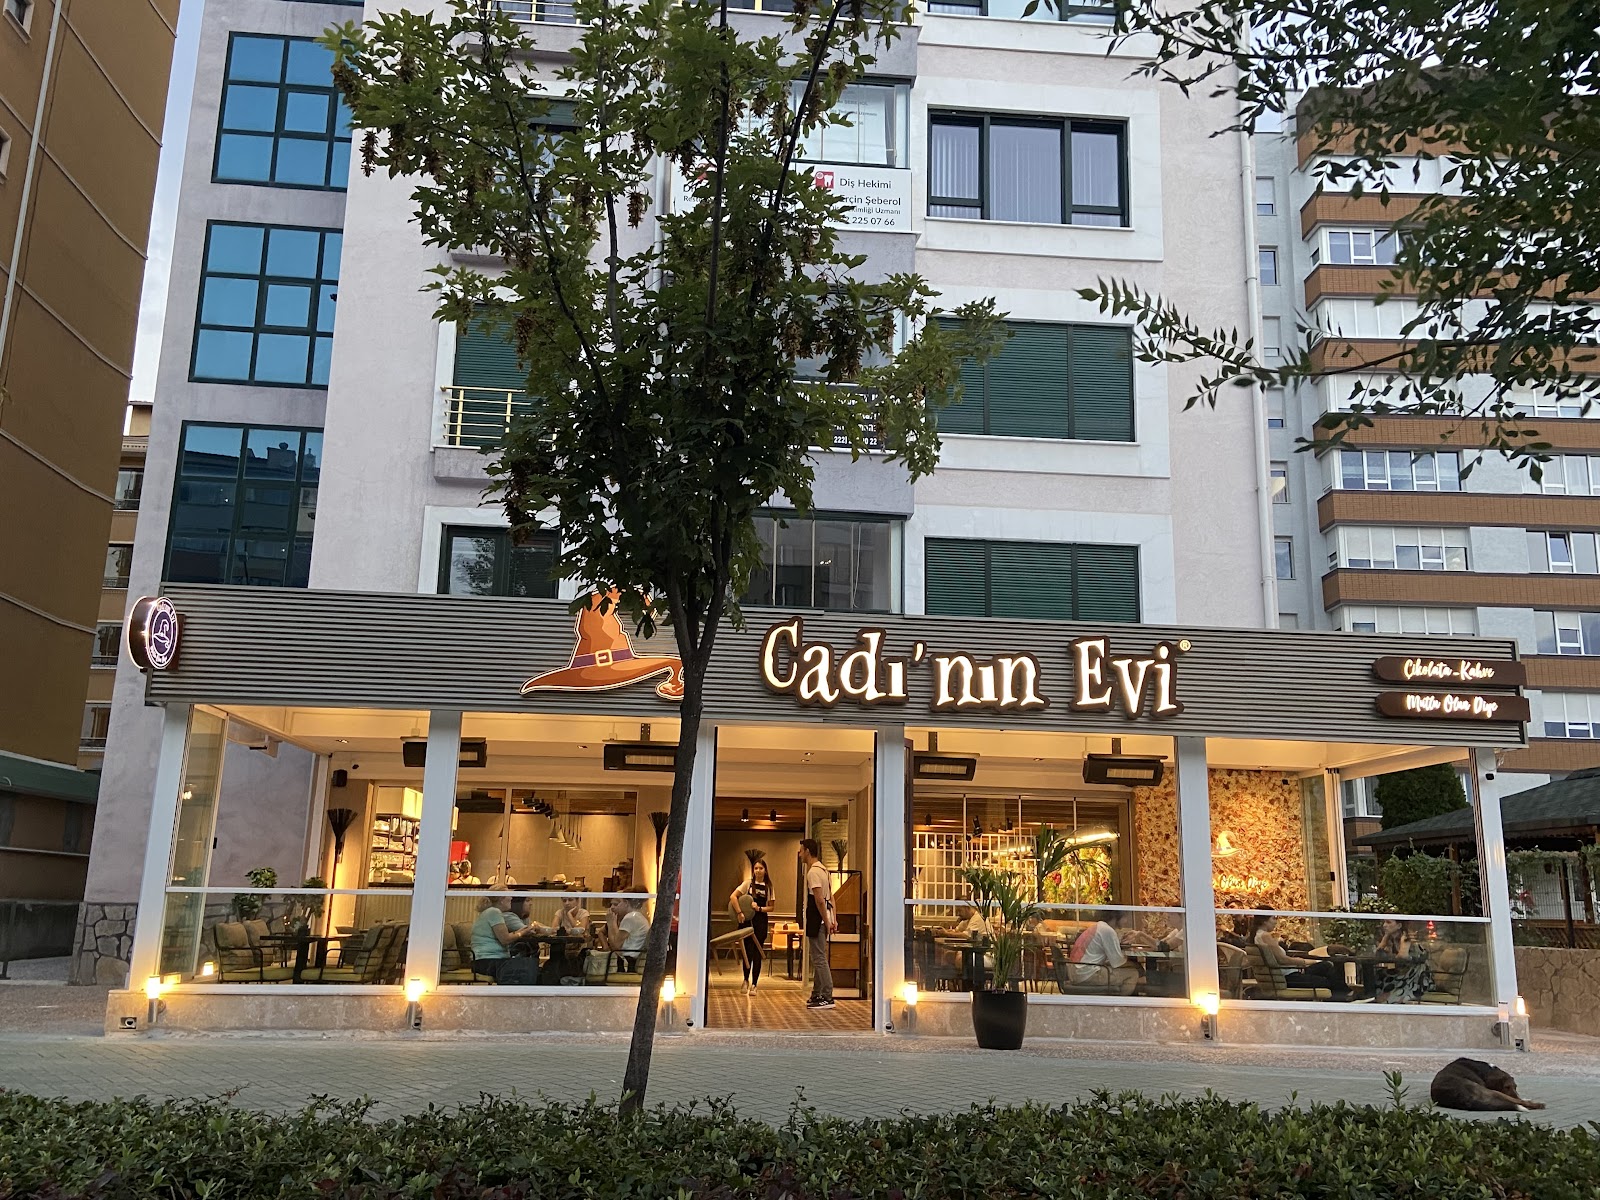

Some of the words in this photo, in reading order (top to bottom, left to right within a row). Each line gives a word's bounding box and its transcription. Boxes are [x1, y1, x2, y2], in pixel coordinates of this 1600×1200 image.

[839, 177, 855, 189] Diş
[857, 179, 892, 189] Hekimi
[865, 195, 901, 206] Şeberol
[875, 207, 901, 215] Uzmanı
[852, 216, 869, 225] 225
[870, 217, 882, 225] 07
[884, 218, 895, 226] 66
[763, 620, 1046, 708] Cadı'nın
[1075, 635, 1179, 714] Evi
